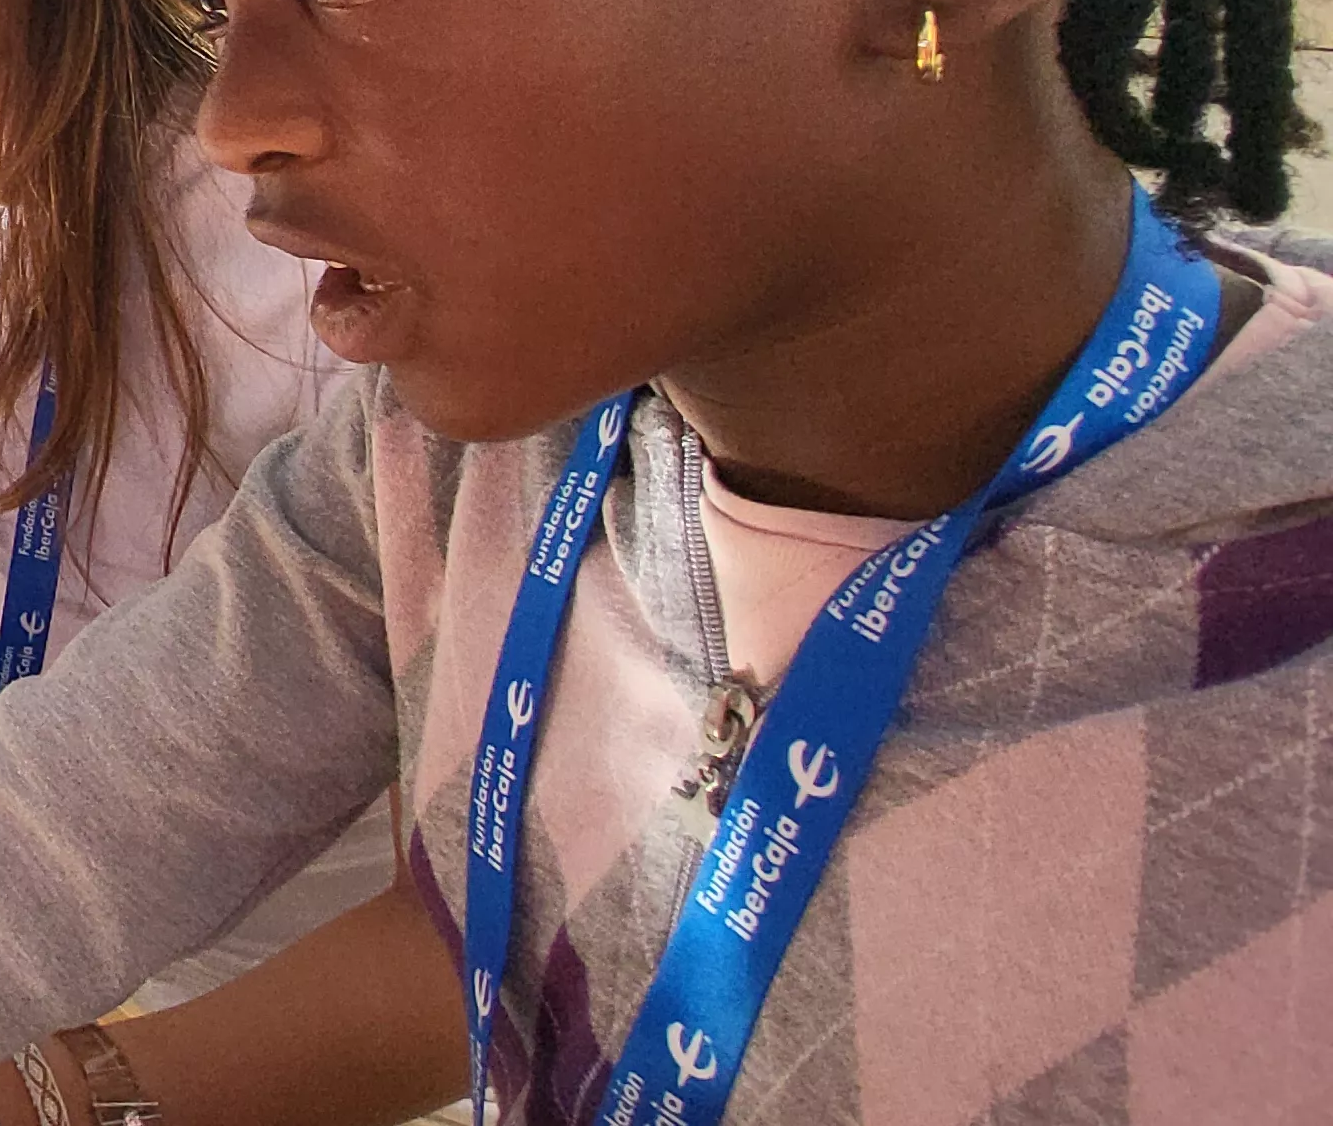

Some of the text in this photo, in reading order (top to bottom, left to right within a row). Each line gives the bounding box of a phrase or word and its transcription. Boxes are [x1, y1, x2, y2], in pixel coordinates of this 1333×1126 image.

[1123, 306, 1205, 423] Fundación
[530, 471, 579, 576] Fundación
[473, 744, 496, 858] Fundación
[695, 798, 761, 915] Fundación
